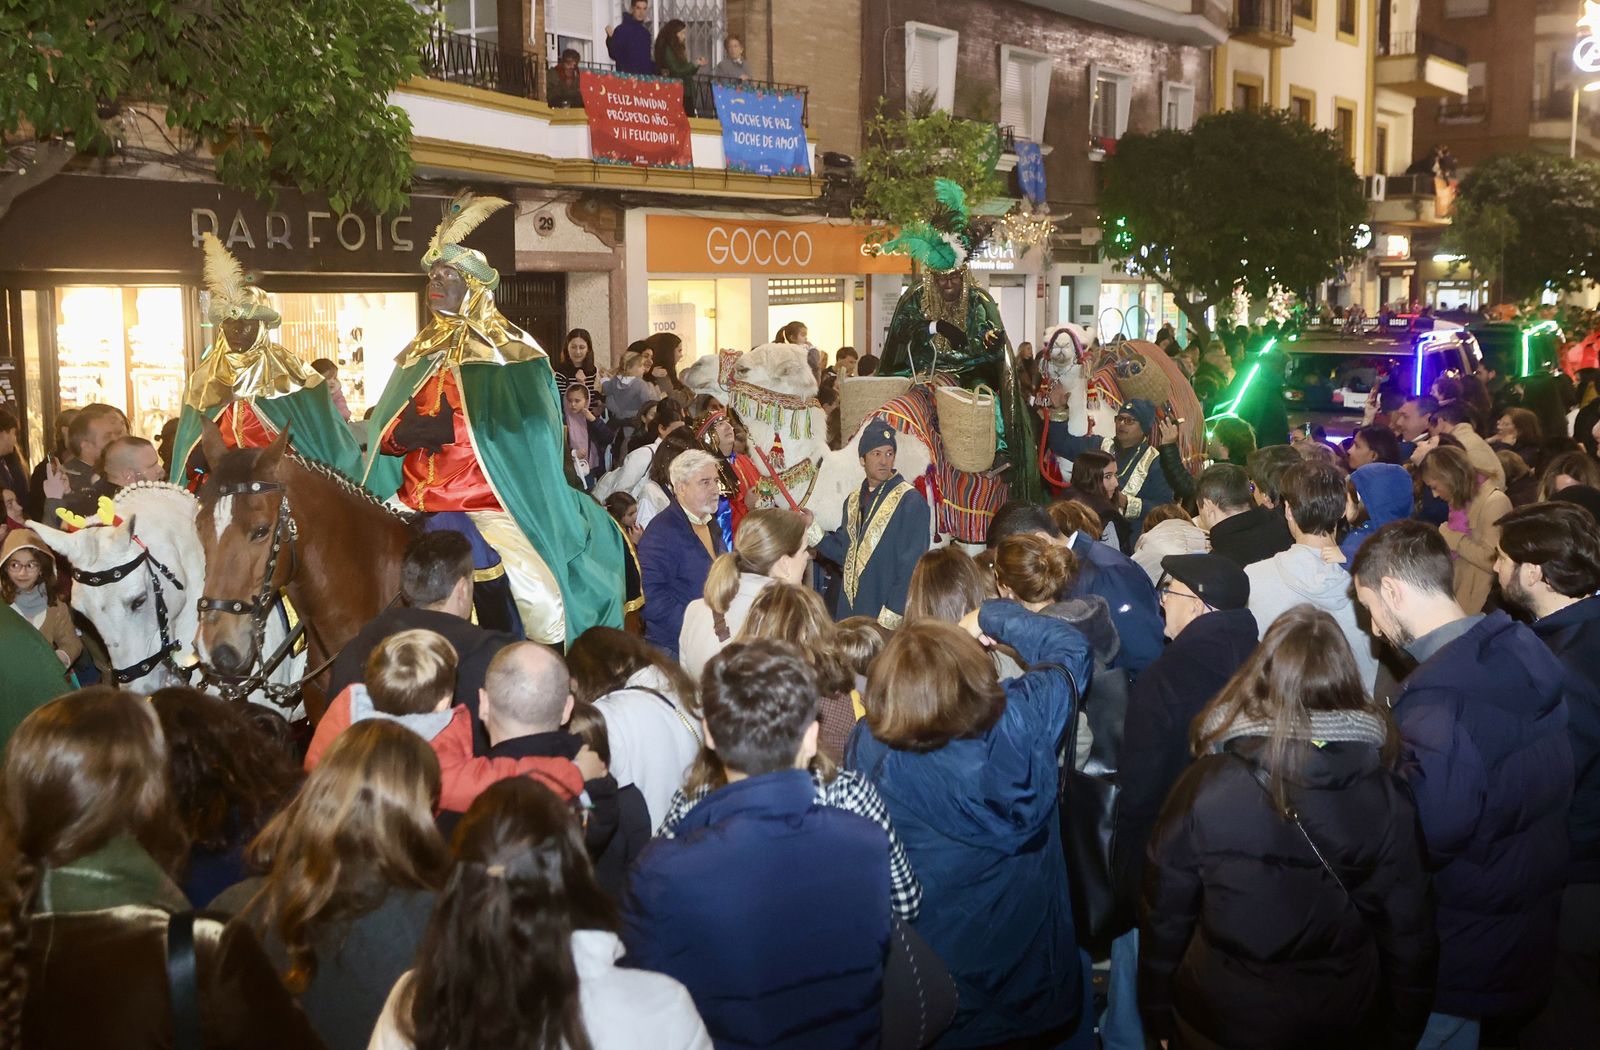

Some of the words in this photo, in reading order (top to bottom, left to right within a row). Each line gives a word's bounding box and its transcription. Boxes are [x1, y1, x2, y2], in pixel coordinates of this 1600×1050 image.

[607, 92, 632, 106] FELIZ
[606, 107, 650, 125] PRÓSPERO
[730, 111, 761, 128] NOCHE
[762, 115, 774, 129] DE
[613, 127, 620, 139] Y
[762, 134, 774, 148] DE
[191, 208, 414, 251] PARFOIS
[539, 216, 554, 231] 29
[706, 226, 813, 266] GOCCO
[653, 320, 676, 332] TODO
